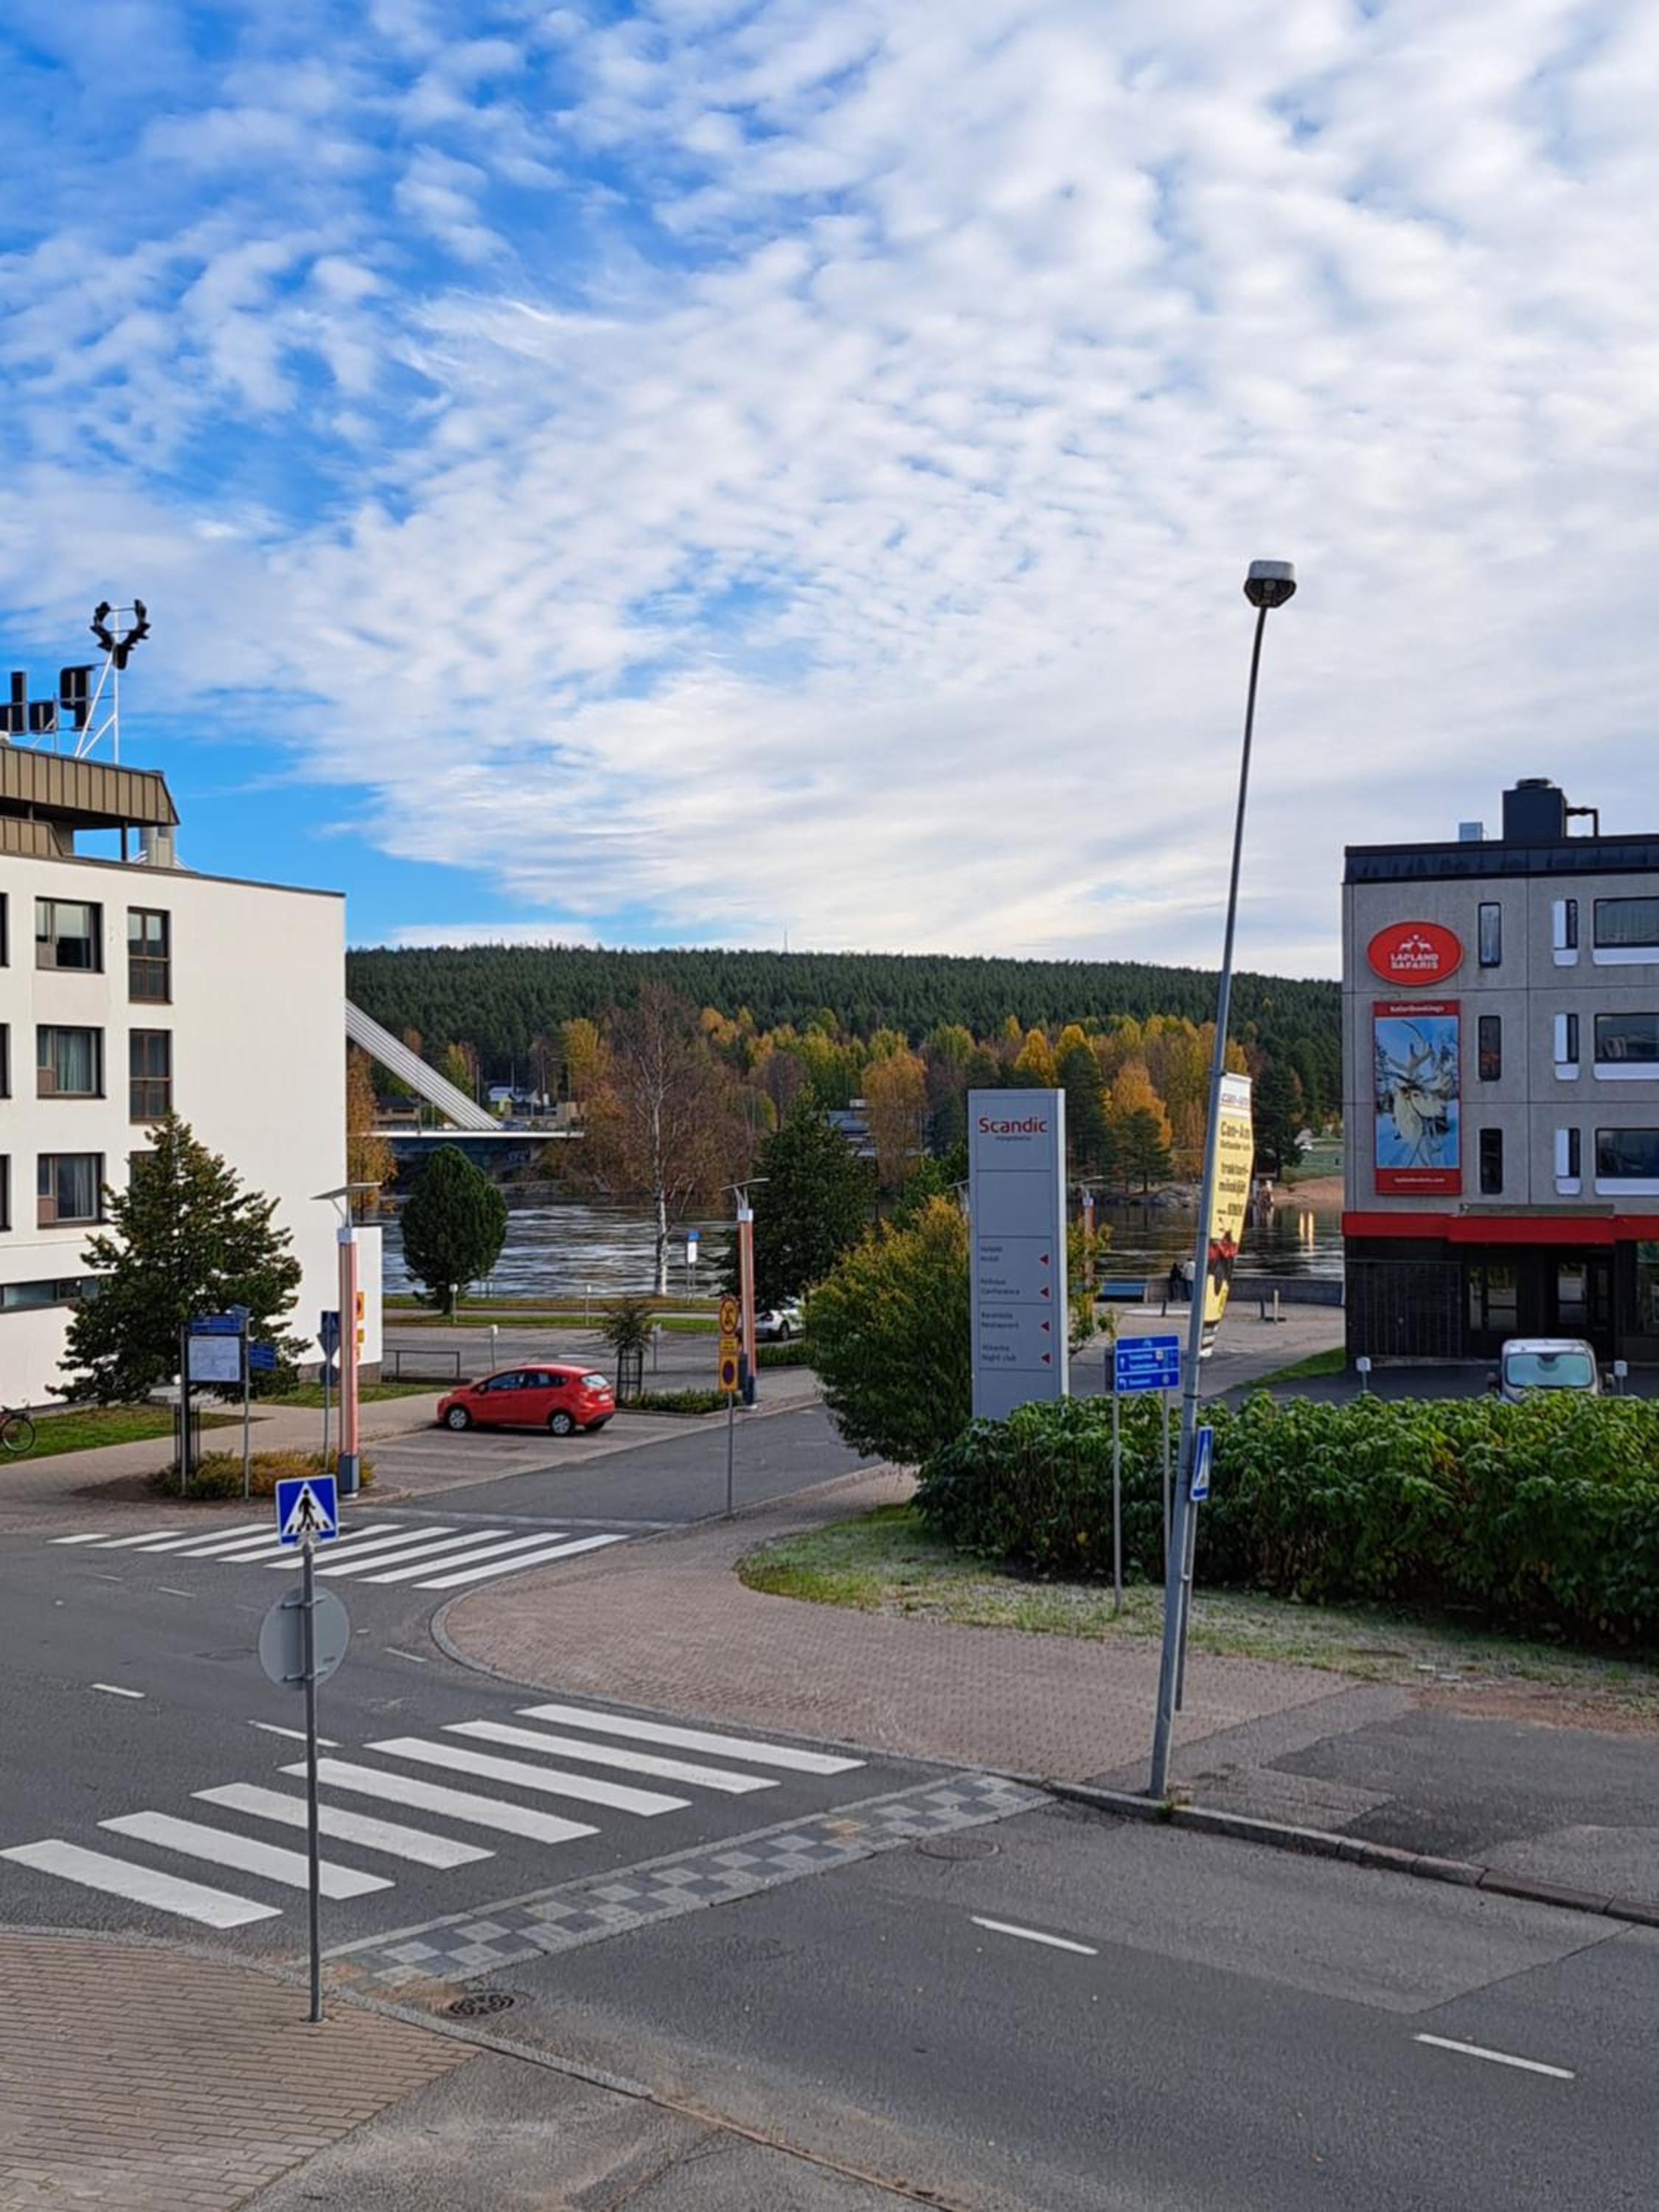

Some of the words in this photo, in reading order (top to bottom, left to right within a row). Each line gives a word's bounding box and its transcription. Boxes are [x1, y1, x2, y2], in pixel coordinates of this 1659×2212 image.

[1390, 952, 1440, 961] LAPLAND
[1391, 961, 1440, 970] SAFARIS
[978, 1116, 1048, 1133] Scandic
